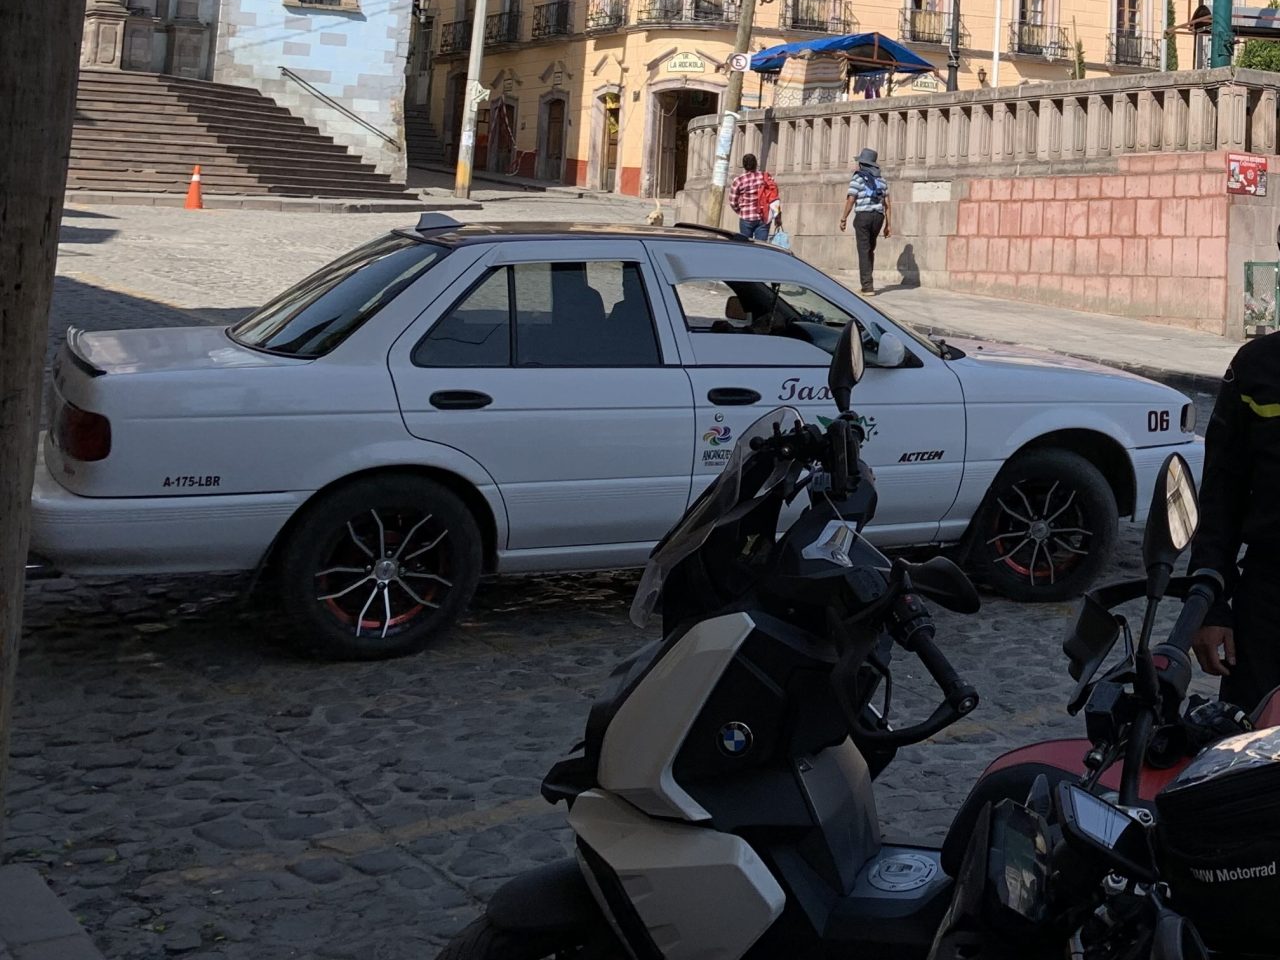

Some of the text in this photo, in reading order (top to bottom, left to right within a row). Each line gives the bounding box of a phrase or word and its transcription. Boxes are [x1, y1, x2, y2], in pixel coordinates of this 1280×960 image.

[778, 377, 834, 401] Tax
[1147, 410, 1170, 432] 06
[898, 449, 945, 463] ACTCEM
[162, 475, 221, 488] A-175-LBR
[1190, 861, 1276, 882] MW Motorrad
